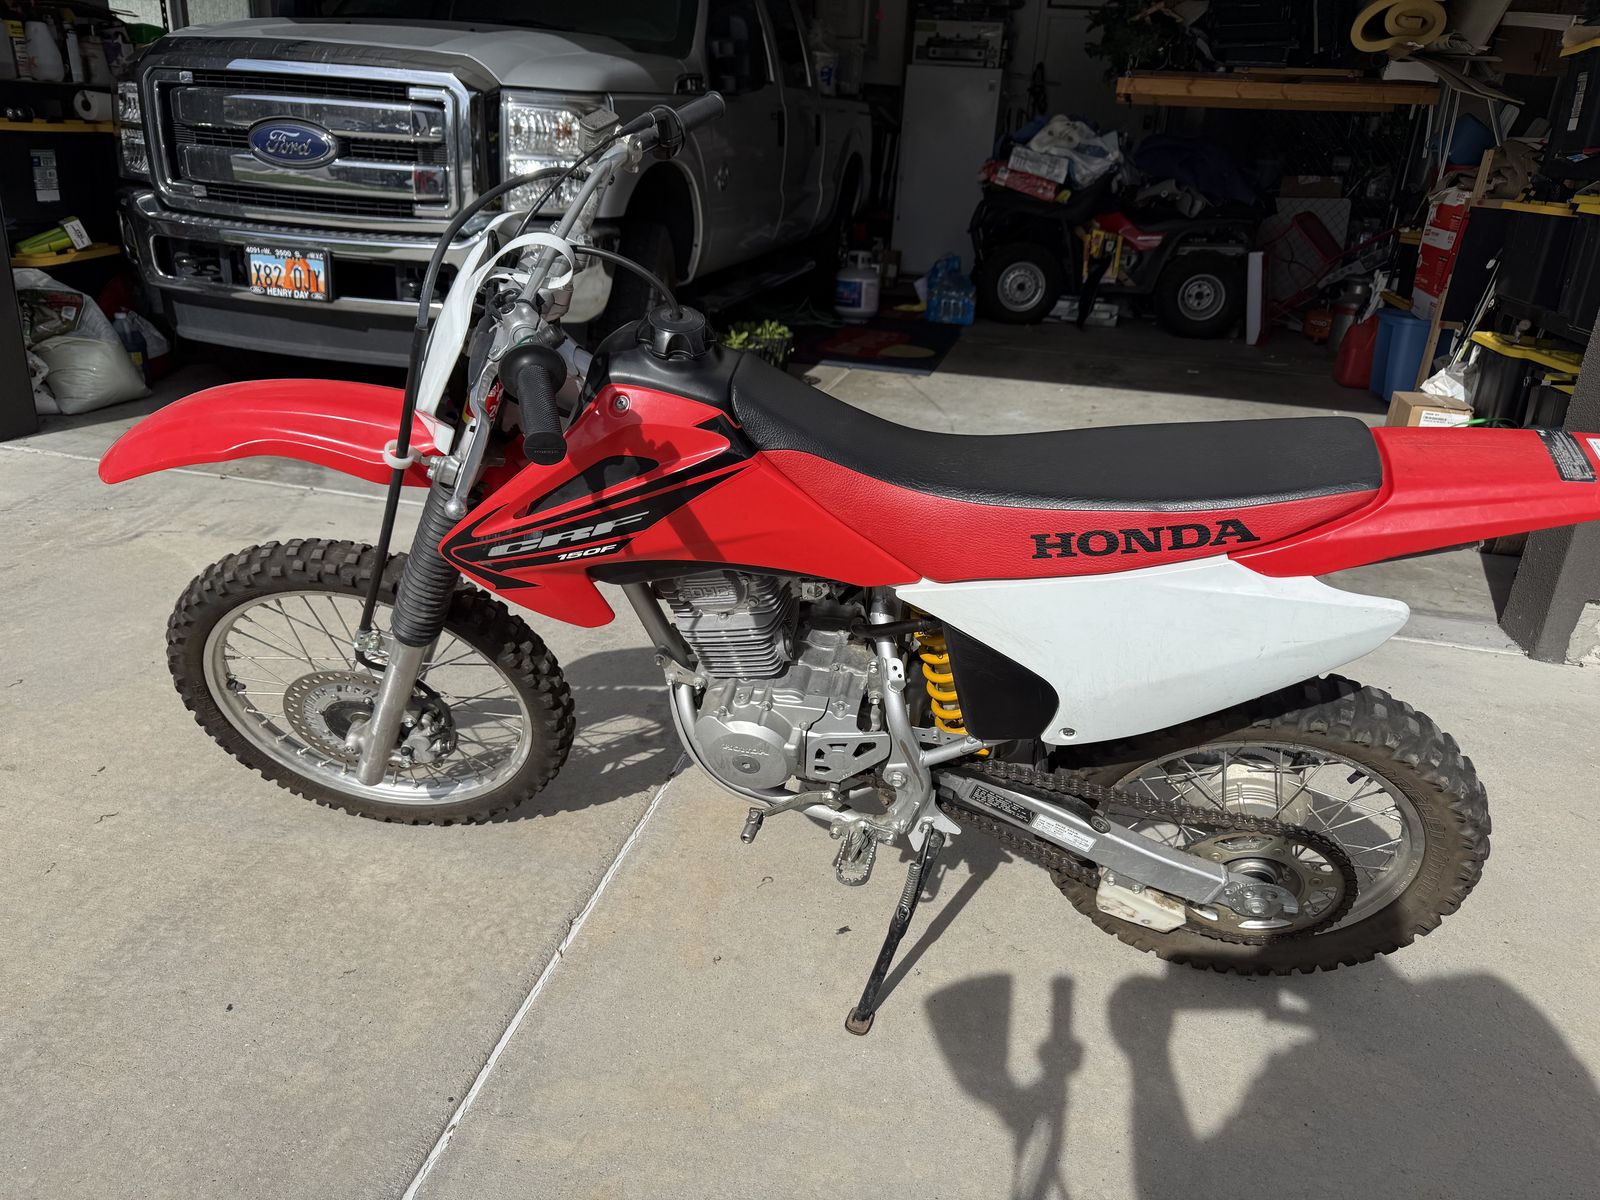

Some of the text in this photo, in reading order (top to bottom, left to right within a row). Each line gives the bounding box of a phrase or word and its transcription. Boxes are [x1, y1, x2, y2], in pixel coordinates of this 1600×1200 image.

[265, 129, 312, 156] Ford
[253, 262, 283, 289] X82
[266, 287, 293, 298] HENRY
[293, 289, 310, 299] DAY
[487, 510, 650, 557] CRF
[1030, 518, 1261, 559] HONDA
[557, 543, 617, 561] 150F
